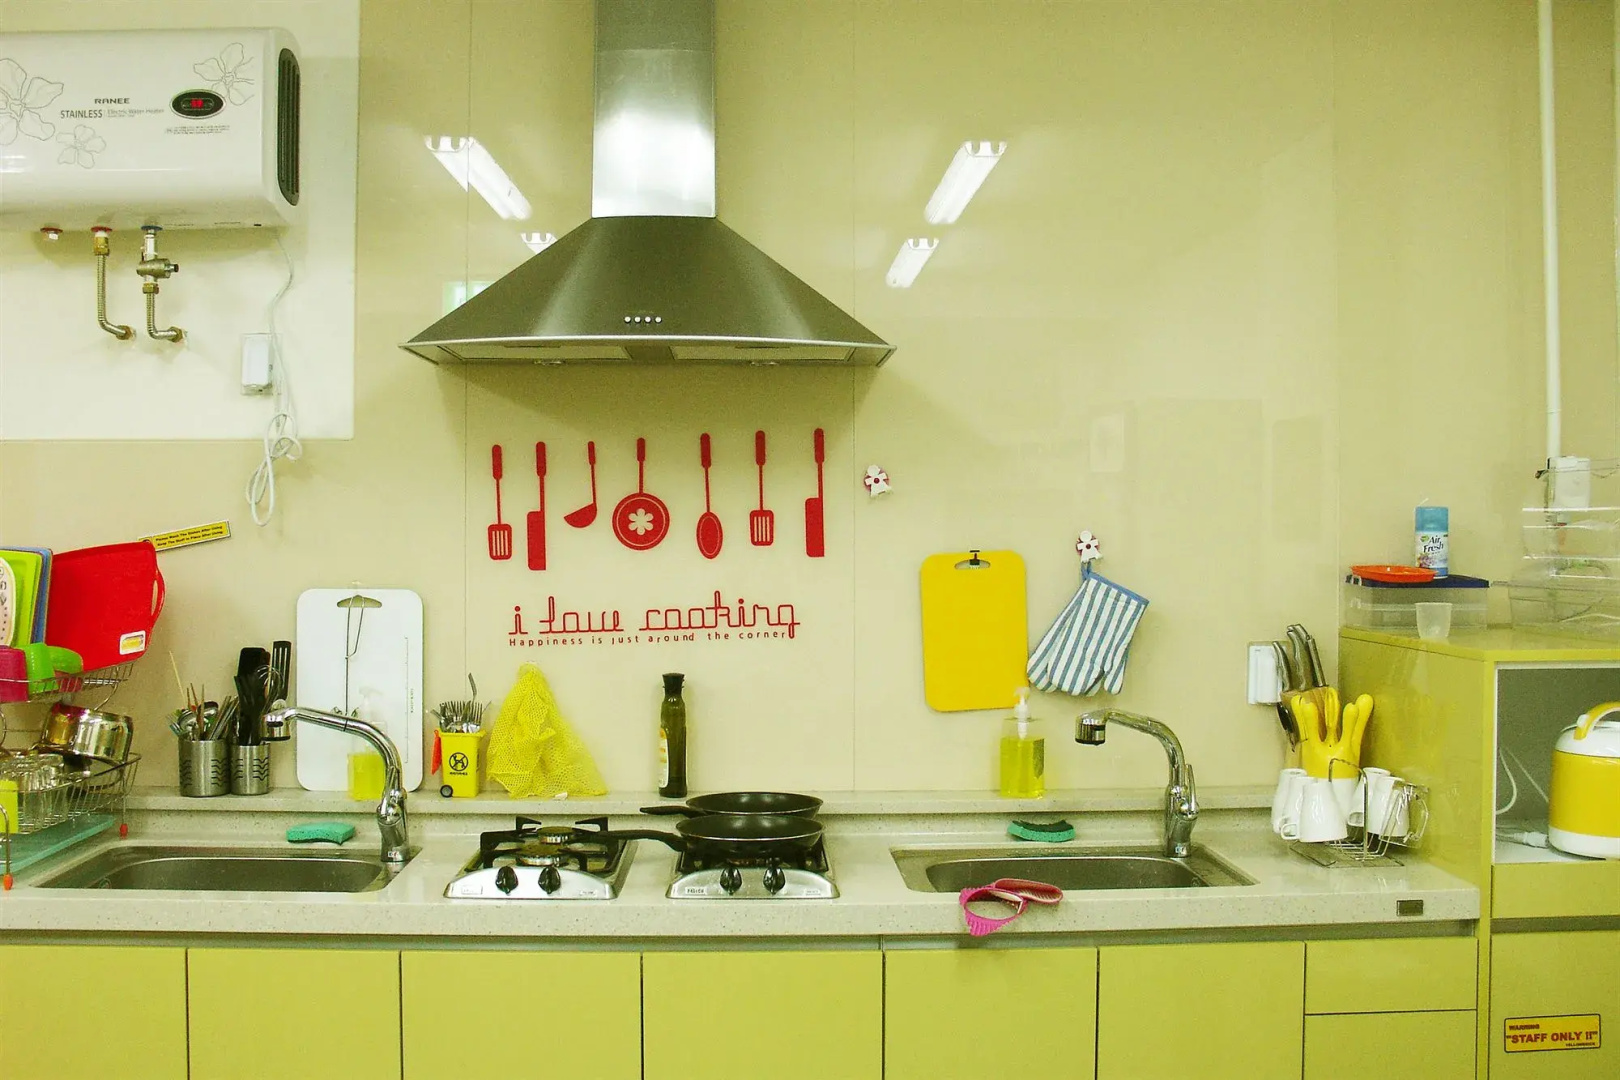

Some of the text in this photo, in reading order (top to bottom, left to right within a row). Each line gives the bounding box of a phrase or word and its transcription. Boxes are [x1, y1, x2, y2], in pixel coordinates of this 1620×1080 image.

[94, 97, 130, 105] RANEE
[60, 109, 103, 119] STAINLESS
[1429, 535, 1441, 544] Air
[1423, 541, 1444, 553] Fresh
[508, 590, 800, 639] i love cooking
[509, 631, 786, 647] Happiness is just around the corner
[1550, 1031, 1583, 1042] ONLY
